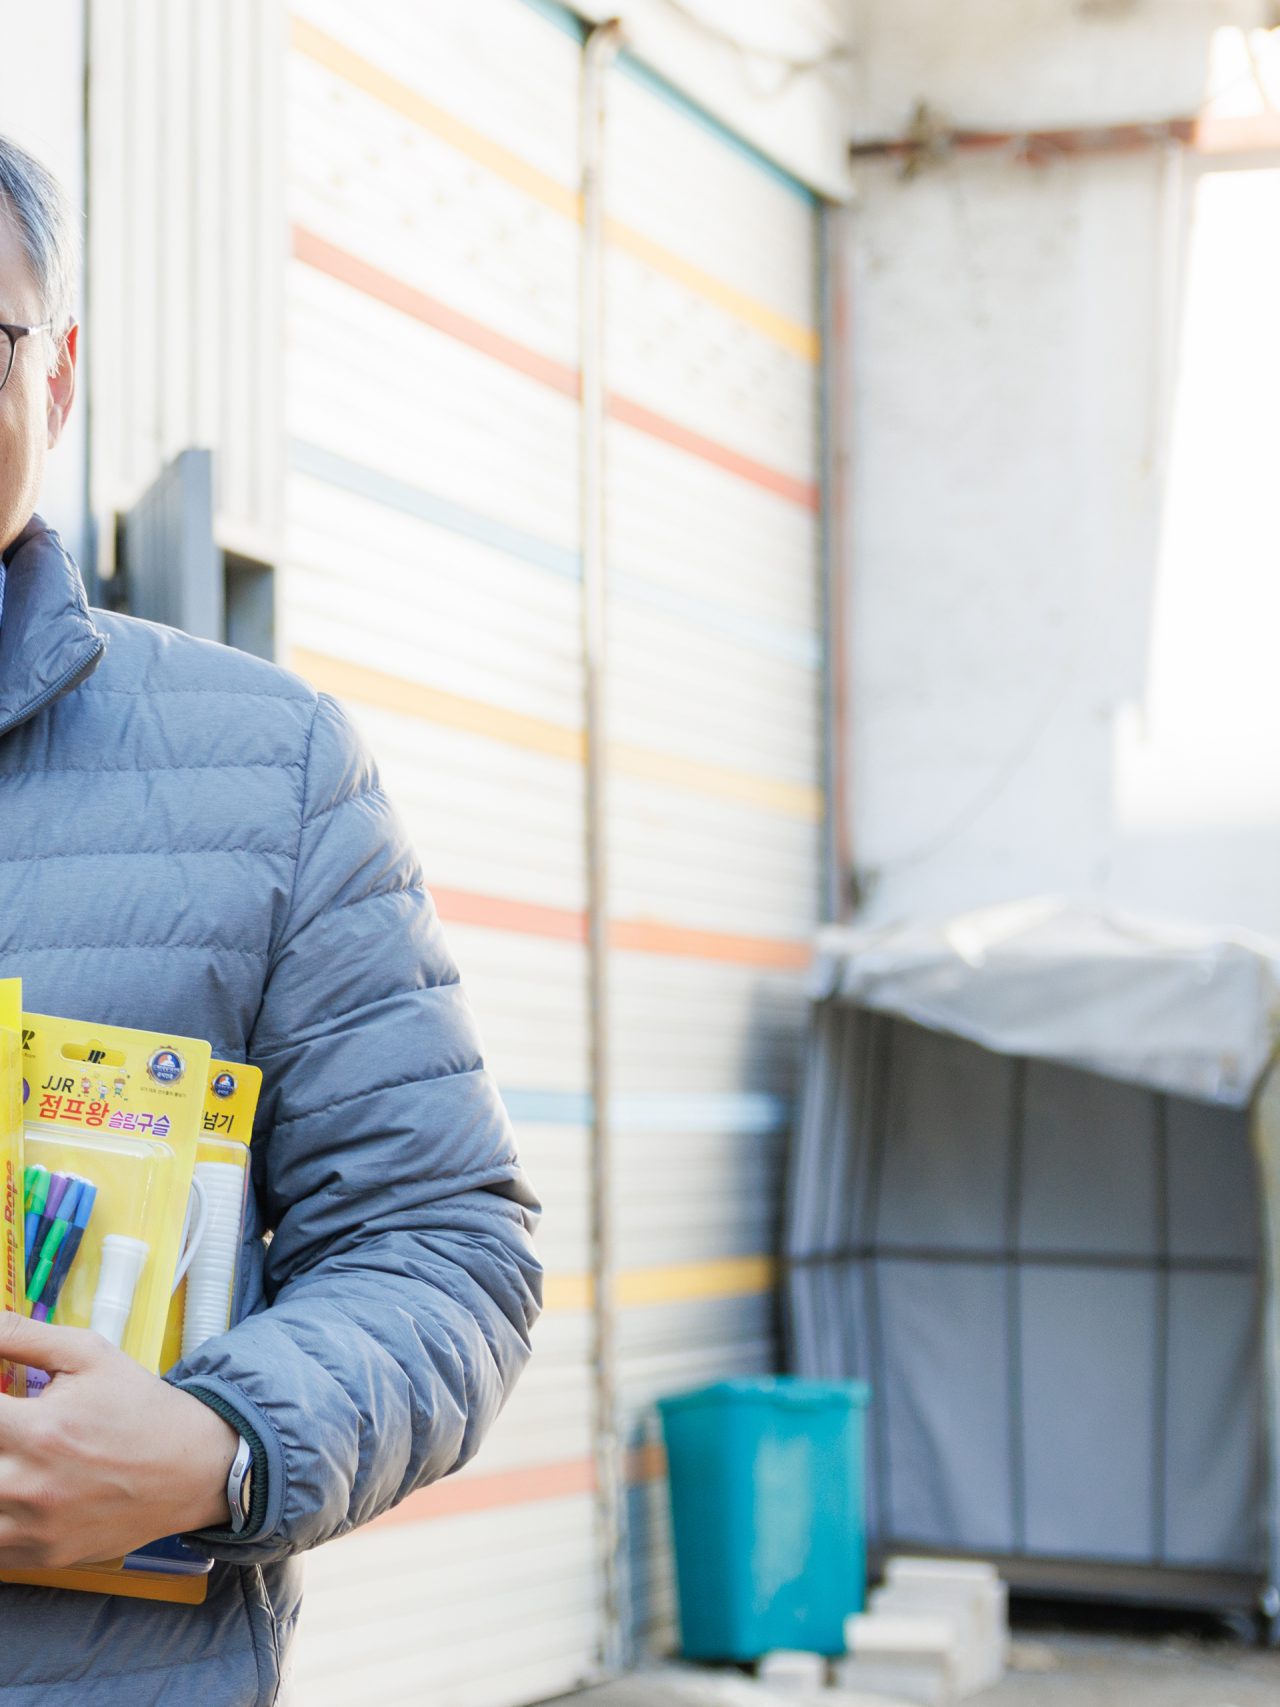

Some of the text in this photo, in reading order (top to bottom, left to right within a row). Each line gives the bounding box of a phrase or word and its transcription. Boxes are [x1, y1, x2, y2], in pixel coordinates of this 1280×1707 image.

[41, 1075, 75, 1093] JJR
[39, 1094, 171, 1137] 점프왕 슬림구슬
[203, 1111, 234, 1134] 넘기
[4, 1160, 18, 1225] Rope
[5, 1228, 18, 1293] Jump
